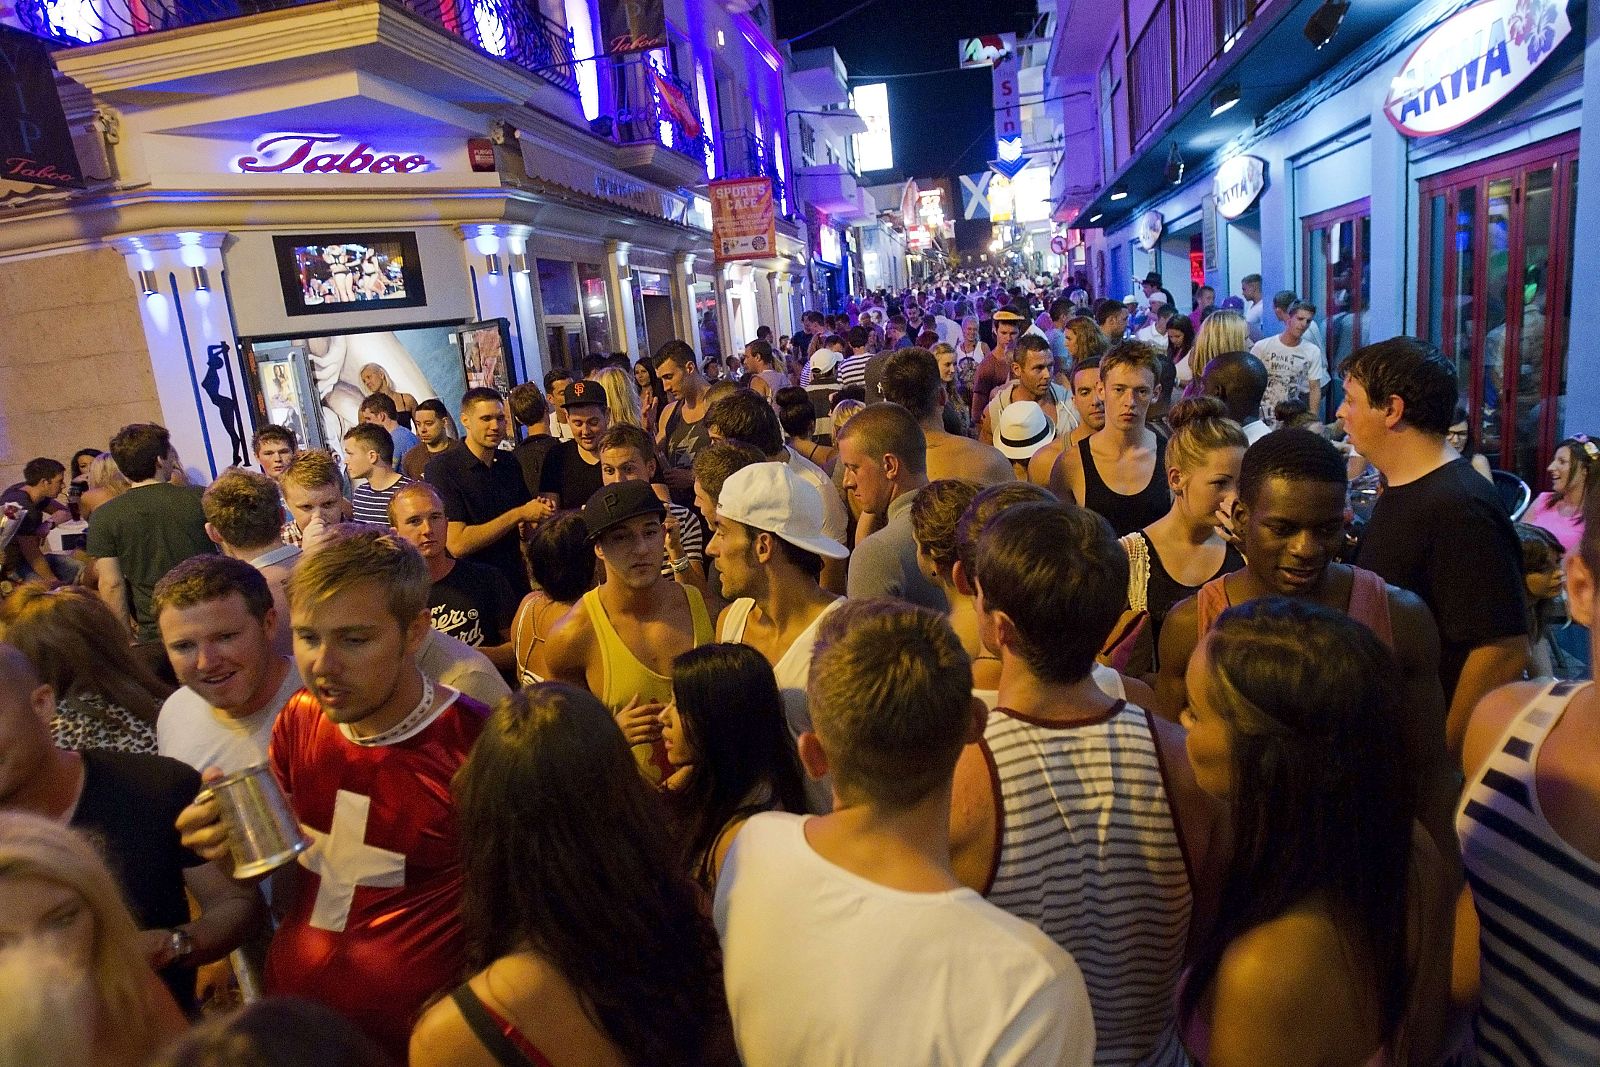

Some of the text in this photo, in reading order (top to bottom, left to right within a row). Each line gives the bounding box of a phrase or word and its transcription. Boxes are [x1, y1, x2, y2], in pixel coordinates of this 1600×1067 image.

[611, 33, 659, 53] Taboo
[1001, 80, 1015, 132] Sin
[238, 135, 432, 174] Taboo
[6, 156, 75, 181] Taboo
[716, 184, 766, 199] SPORTS
[728, 197, 757, 210] CAFE
[430, 609, 468, 628] ers
